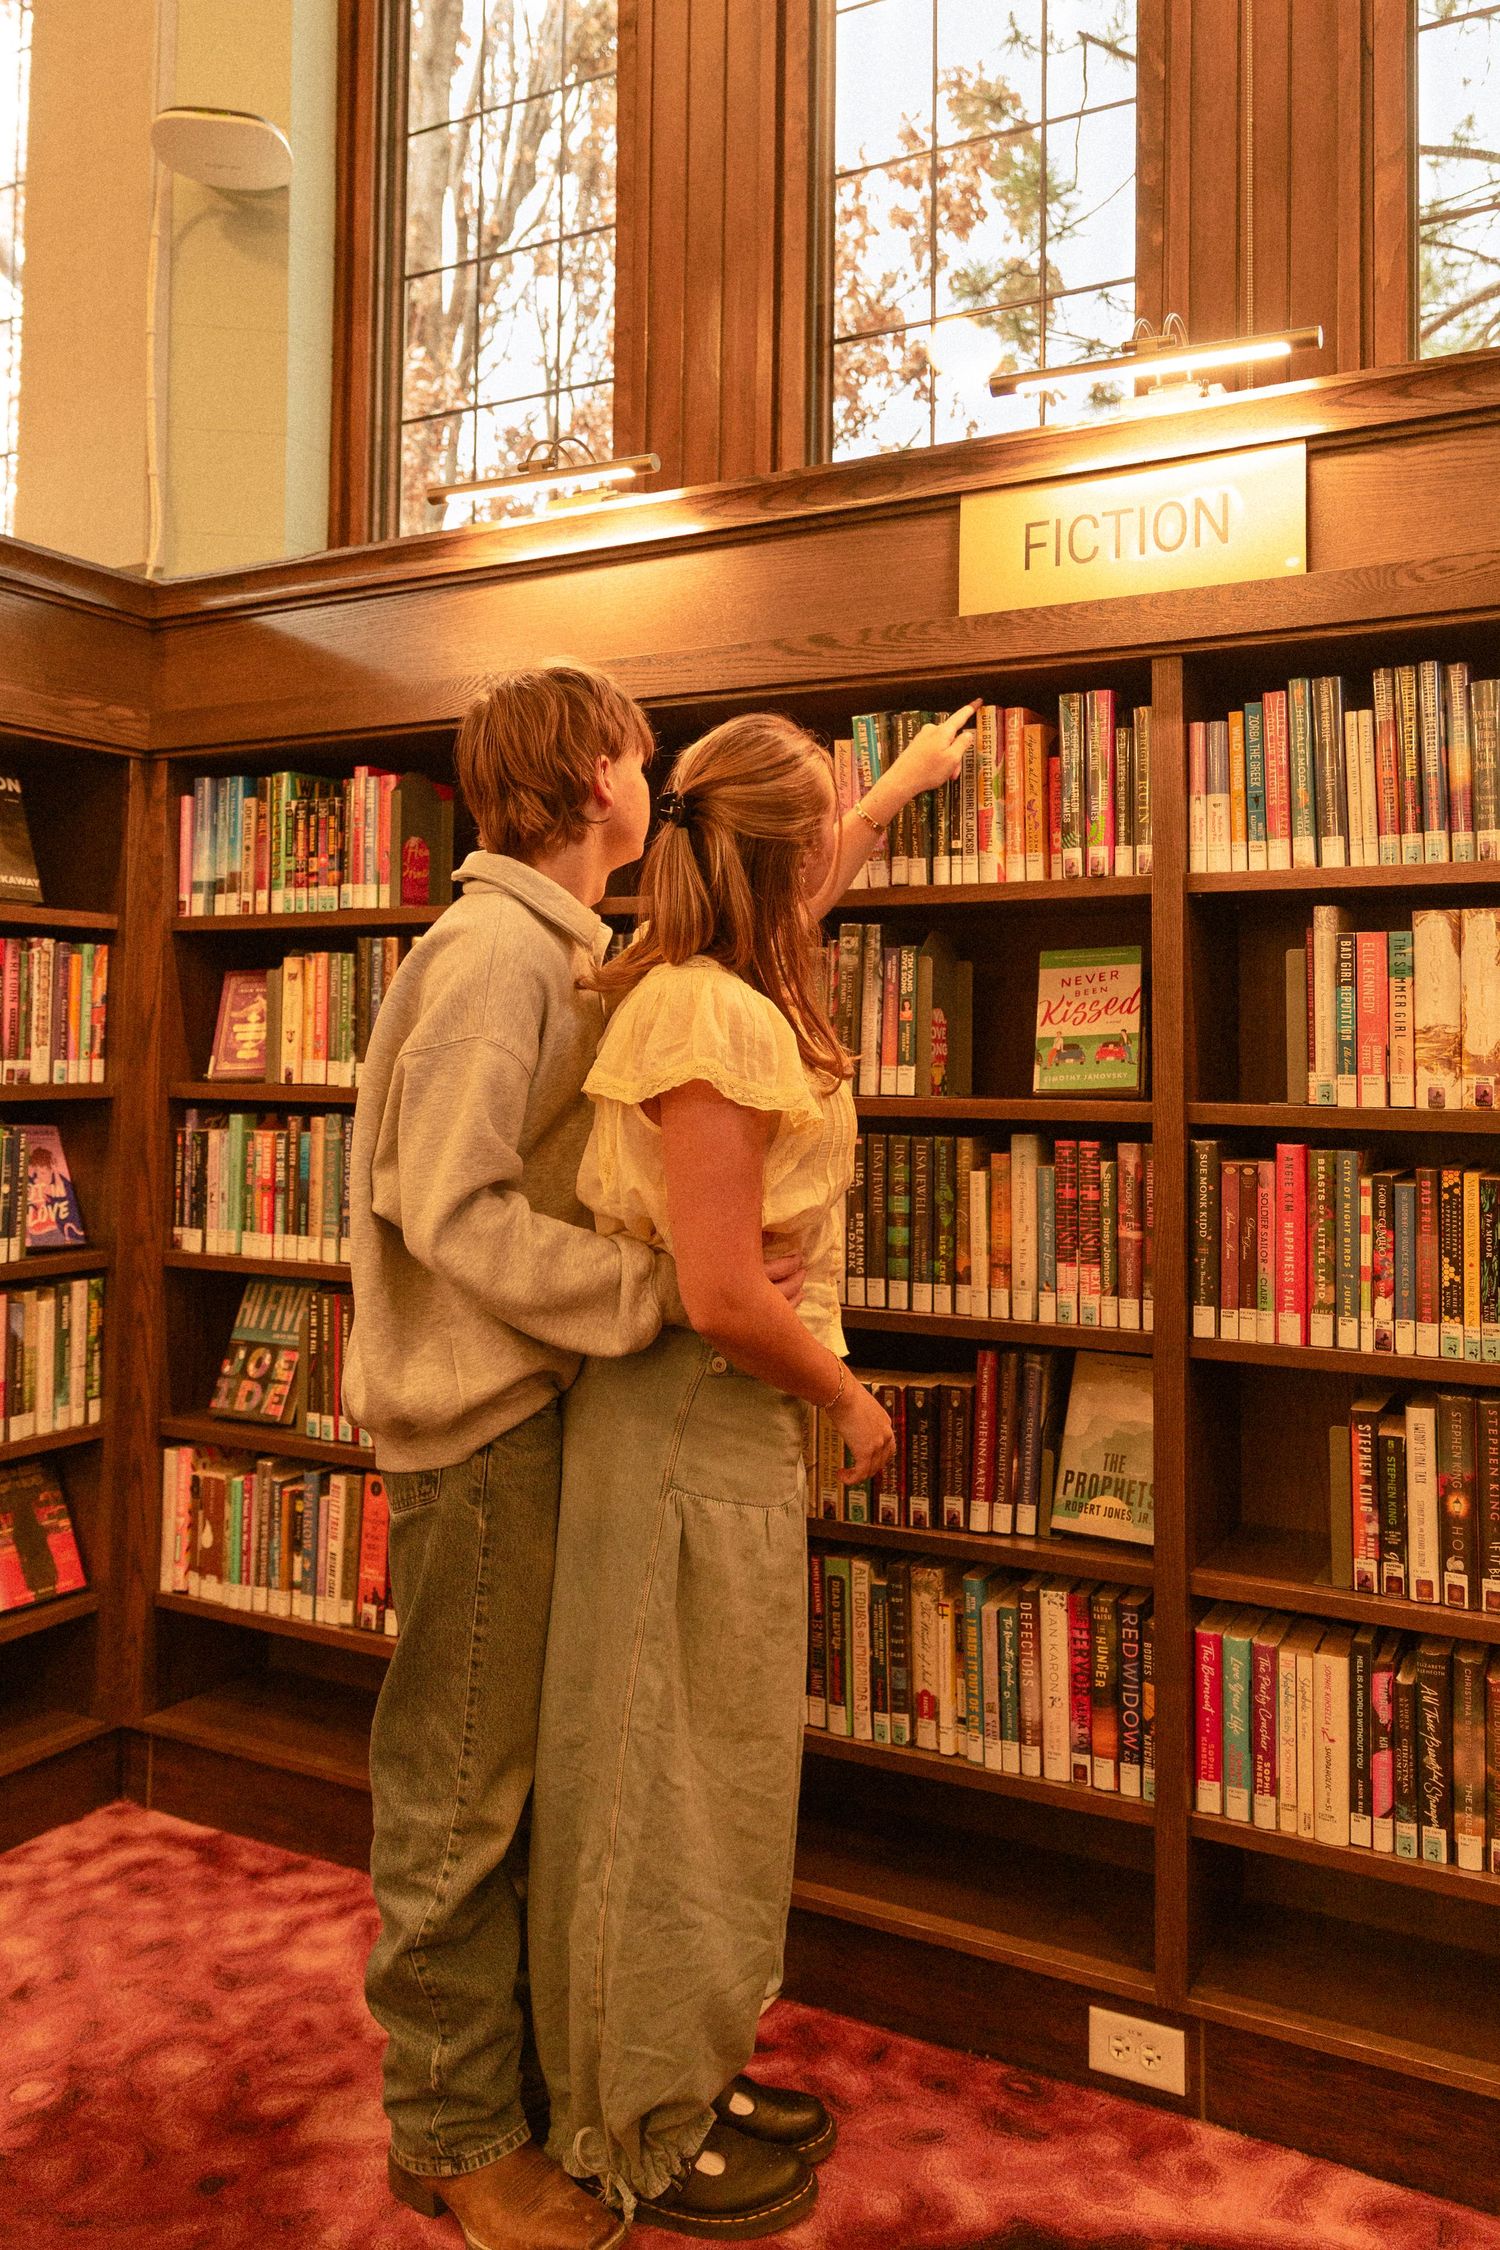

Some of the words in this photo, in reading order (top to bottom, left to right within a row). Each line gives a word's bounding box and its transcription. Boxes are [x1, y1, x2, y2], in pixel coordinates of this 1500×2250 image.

[1024, 493, 1229, 571] FICTION
[1375, 677, 1386, 722] KELLERMAN
[1401, 670, 1415, 718] JONATHAN
[1423, 665, 1437, 714] JONATHAN
[1452, 669, 1463, 716] JONATHAN
[982, 714, 991, 732] OUR
[1008, 716, 1019, 740] Old
[1248, 714, 1260, 743] ZORBA
[1296, 704, 1304, 725] THE
[858, 721, 868, 748] JENNY
[982, 734, 992, 755] BEST
[1090, 720, 1098, 750] SPIDER
[1232, 725, 1241, 752] WILD
[1404, 720, 1417, 777] KELLERMAN
[1426, 716, 1438, 773] KELLERMAN
[861, 749, 873, 787] JACKSON
[1006, 743, 1018, 793] Enough
[1091, 750, 1099, 771] KING
[1139, 730, 1148, 774] BRIGHT
[1250, 744, 1260, 760] THE
[982, 757, 993, 808] INTENTIONS
[1055, 772, 1060, 784] OF
[1233, 755, 1243, 790] THINGS
[1250, 761, 1261, 787] GREEK
[1298, 757, 1306, 790] MOON
[244, 803, 253, 822] JOE
[259, 800, 267, 817] JOE
[965, 788, 974, 821] SHIRLEY
[1063, 797, 1071, 823] JAMES
[1071, 781, 1079, 813] MARLON
[1090, 794, 1099, 821] JAMES
[1138, 779, 1149, 824] RUIN
[1324, 765, 1336, 829] bellewether
[244, 826, 253, 843] HILL
[259, 818, 267, 837] HILL
[1341, 940, 1352, 959] BAD
[1362, 942, 1374, 965] ELLE
[1394, 938, 1406, 957] THE
[1061, 970, 1120, 988] NEVER
[1341, 962, 1352, 983] GIRL
[1394, 961, 1406, 1008] SUMMER
[1039, 986, 1142, 1027] Kissed
[1074, 986, 1108, 998] BEEN
[1363, 967, 1375, 1014] KENNEDY
[1341, 985, 1353, 1041] REPUTATION
[1394, 1012, 1406, 1040] GIRL
[1361, 1044, 1370, 1069] EFFECT
[1044, 1075, 1081, 1083] TIMOTHY
[1083, 1072, 1128, 1081] JANOVSKY
[276, 1138, 285, 1159] THIS
[873, 1143, 883, 1169] LISA
[894, 1144, 904, 1169] LISA
[915, 1144, 926, 1170] LISA
[1199, 1153, 1207, 1175] SUE
[276, 1160, 285, 1182] GIRL
[856, 1162, 864, 1187] LISA
[1284, 1155, 1294, 1187] ANGIE
[1317, 1158, 1325, 1201] BEASTS
[1343, 1159, 1351, 1182] CITY
[872, 1172, 883, 1215] JEWELL
[894, 1172, 905, 1214] JEWELL
[915, 1173, 927, 1216] JEWELL
[1103, 1172, 1111, 1208] Sisters
[1199, 1176, 1208, 1209] MONK
[1284, 1192, 1294, 1213] KIM
[1343, 1186, 1351, 1199] OF
[27, 1200, 70, 1232] LOVE
[1200, 1211, 1208, 1238] KIDD
[1260, 1191, 1269, 1230] SOLDIER
[1343, 1202, 1351, 1235] NIGHT
[856, 1212, 864, 1275] BREAKING
[1101, 1217, 1111, 1244] Daisy
[1317, 1227, 1325, 1264] LITTLE
[1376, 1218, 1387, 1258] GUMIHO
[1485, 1229, 1493, 1258] MOOR
[1260, 1231, 1269, 1264] SAILOR
[1284, 1222, 1294, 1283] HAPPINESS
[1343, 1237, 1351, 1268] BIRDS
[1103, 1246, 1111, 1289] Johnson
[1260, 1277, 1268, 1306] CLAIRE
[1343, 1284, 1351, 1317] JUHEA
[220, 1346, 300, 1381] JOE
[209, 1376, 290, 1417] IDE
[978, 1420, 989, 1465] HENNA
[1358, 1424, 1371, 1477] STEPHEN
[1451, 1411, 1462, 1460] STEPHEN
[1488, 1409, 1499, 1477] STEPHEN
[1103, 1452, 1127, 1473] THE
[1386, 1455, 1396, 1499] STEPHEN
[1452, 1461, 1463, 1489] KING
[330, 1483, 341, 1515] BULLET
[1064, 1500, 1102, 1518] ROBERT
[1102, 1506, 1134, 1523] JONES,
[1360, 1484, 1372, 1513] KING
[1387, 1501, 1397, 1525] KING
[1490, 1483, 1500, 1520] KING
[303, 1483, 313, 1550] SPARROW
[329, 1516, 340, 1541] TRAIN
[854, 1567, 866, 1588] ALL
[855, 1591, 866, 1629] FOURS
[1048, 1611, 1057, 1638] JAN
[1122, 1611, 1139, 1658] RED
[1073, 1627, 1090, 1697] FERVOR
[1095, 1636, 1109, 1688] HUNGER
[1143, 1642, 1152, 1676] BODIES
[1201, 1640, 1214, 1662] The
[1259, 1654, 1271, 1673] The
[1050, 1643, 1059, 1693] KARON
[1230, 1656, 1243, 1681] Love
[1201, 1663, 1215, 1715] Burnout
[1229, 1682, 1244, 1711] Your
[1255, 1675, 1272, 1706] Party
[1420, 1682, 1439, 1704] All
[1464, 1668, 1472, 1717] CHRISTINA
[1122, 1662, 1139, 1751] WIDOW
[1423, 1706, 1440, 1733] These
[1227, 1713, 1244, 1736] Life
[1258, 1708, 1272, 1752] Crasher
[1401, 1738, 1409, 1794] CHRISTMAS
[1420, 1731, 1443, 1783] Beautiful
[1464, 1783, 1473, 1804] THE
